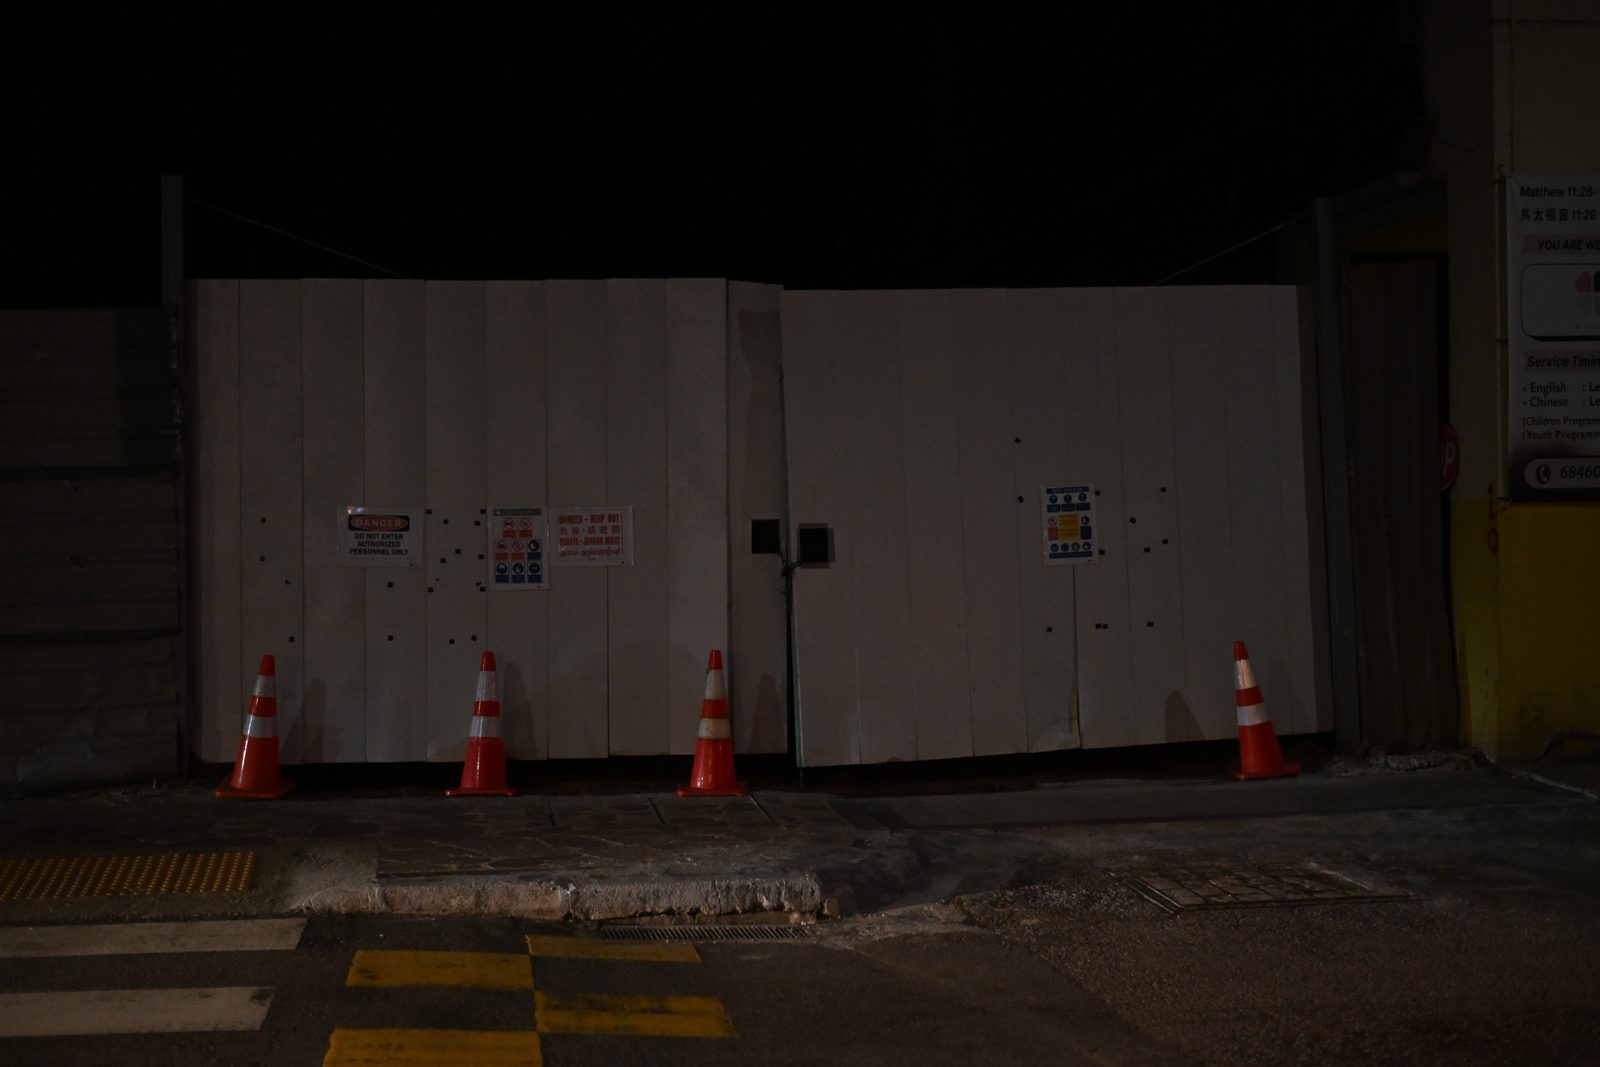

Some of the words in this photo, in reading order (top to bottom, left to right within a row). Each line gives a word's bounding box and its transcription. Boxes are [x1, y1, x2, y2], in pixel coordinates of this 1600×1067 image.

[1520, 186, 1565, 198] Matthew
[1537, 239, 1561, 251] YOU
[1562, 239, 1583, 251] ARE
[1527, 355, 1569, 368] Service
[1530, 382, 1567, 397] English
[1530, 396, 1569, 407] Chinese
[356, 518, 402, 528] DANGER
[590, 514, 605, 524] KEEP
[348, 548, 390, 556] PERSONNEL
[391, 548, 409, 556] ONLY
